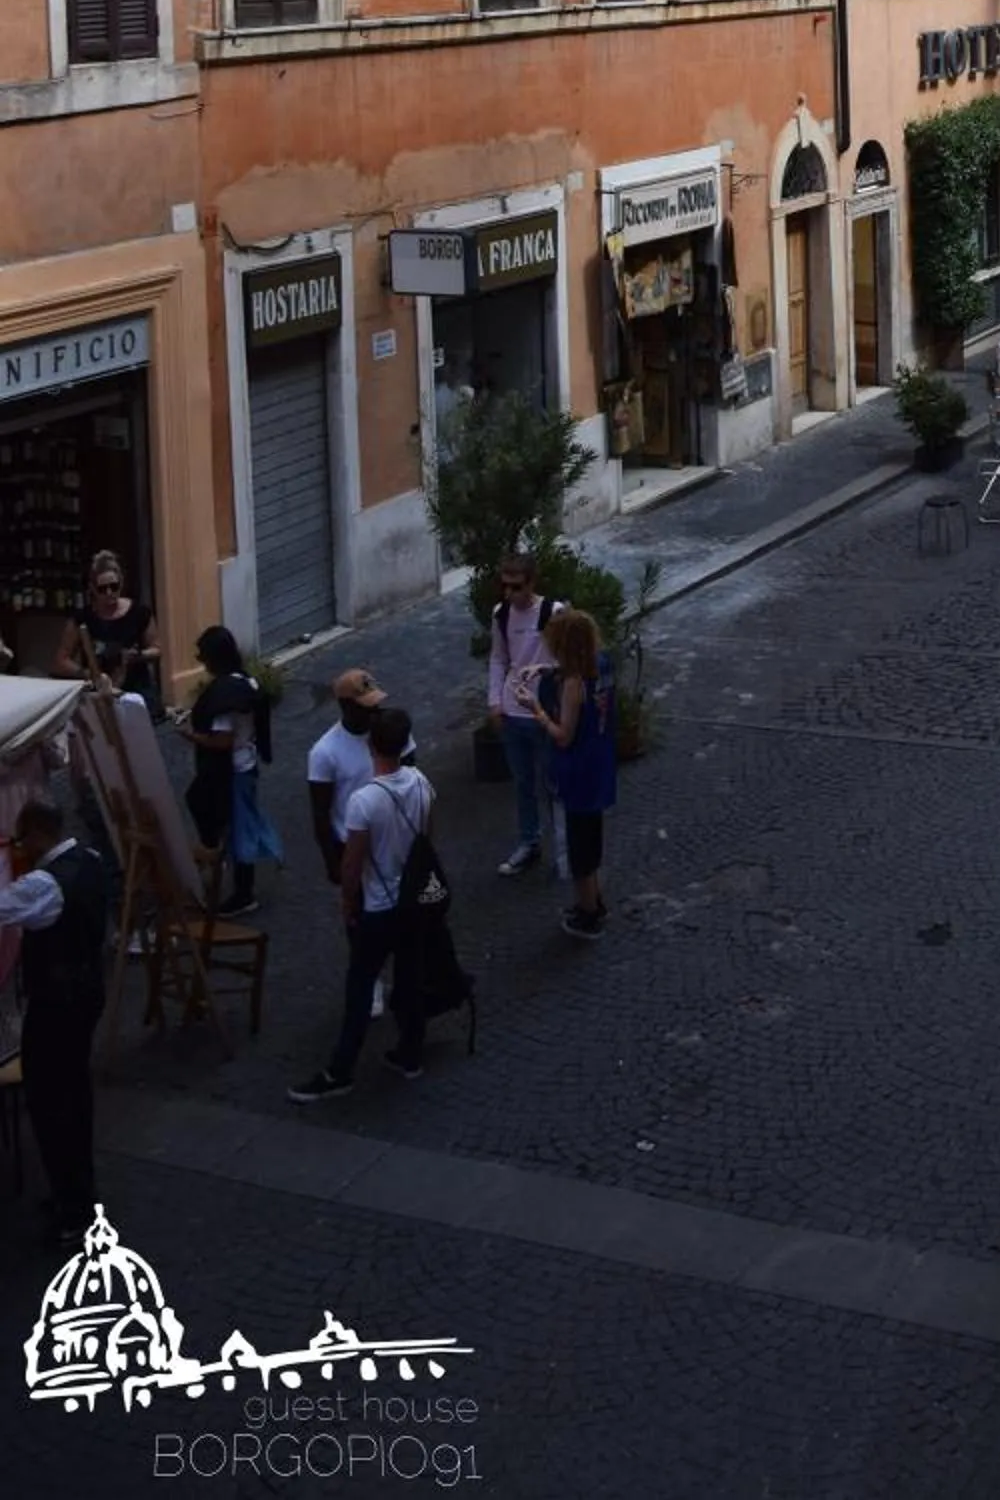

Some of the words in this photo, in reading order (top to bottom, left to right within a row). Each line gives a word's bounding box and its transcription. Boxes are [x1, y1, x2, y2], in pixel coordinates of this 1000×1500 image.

[418, 237, 463, 261] BORGO
[488, 228, 556, 275] FRANCA
[252, 275, 338, 331] HOSTARIA
